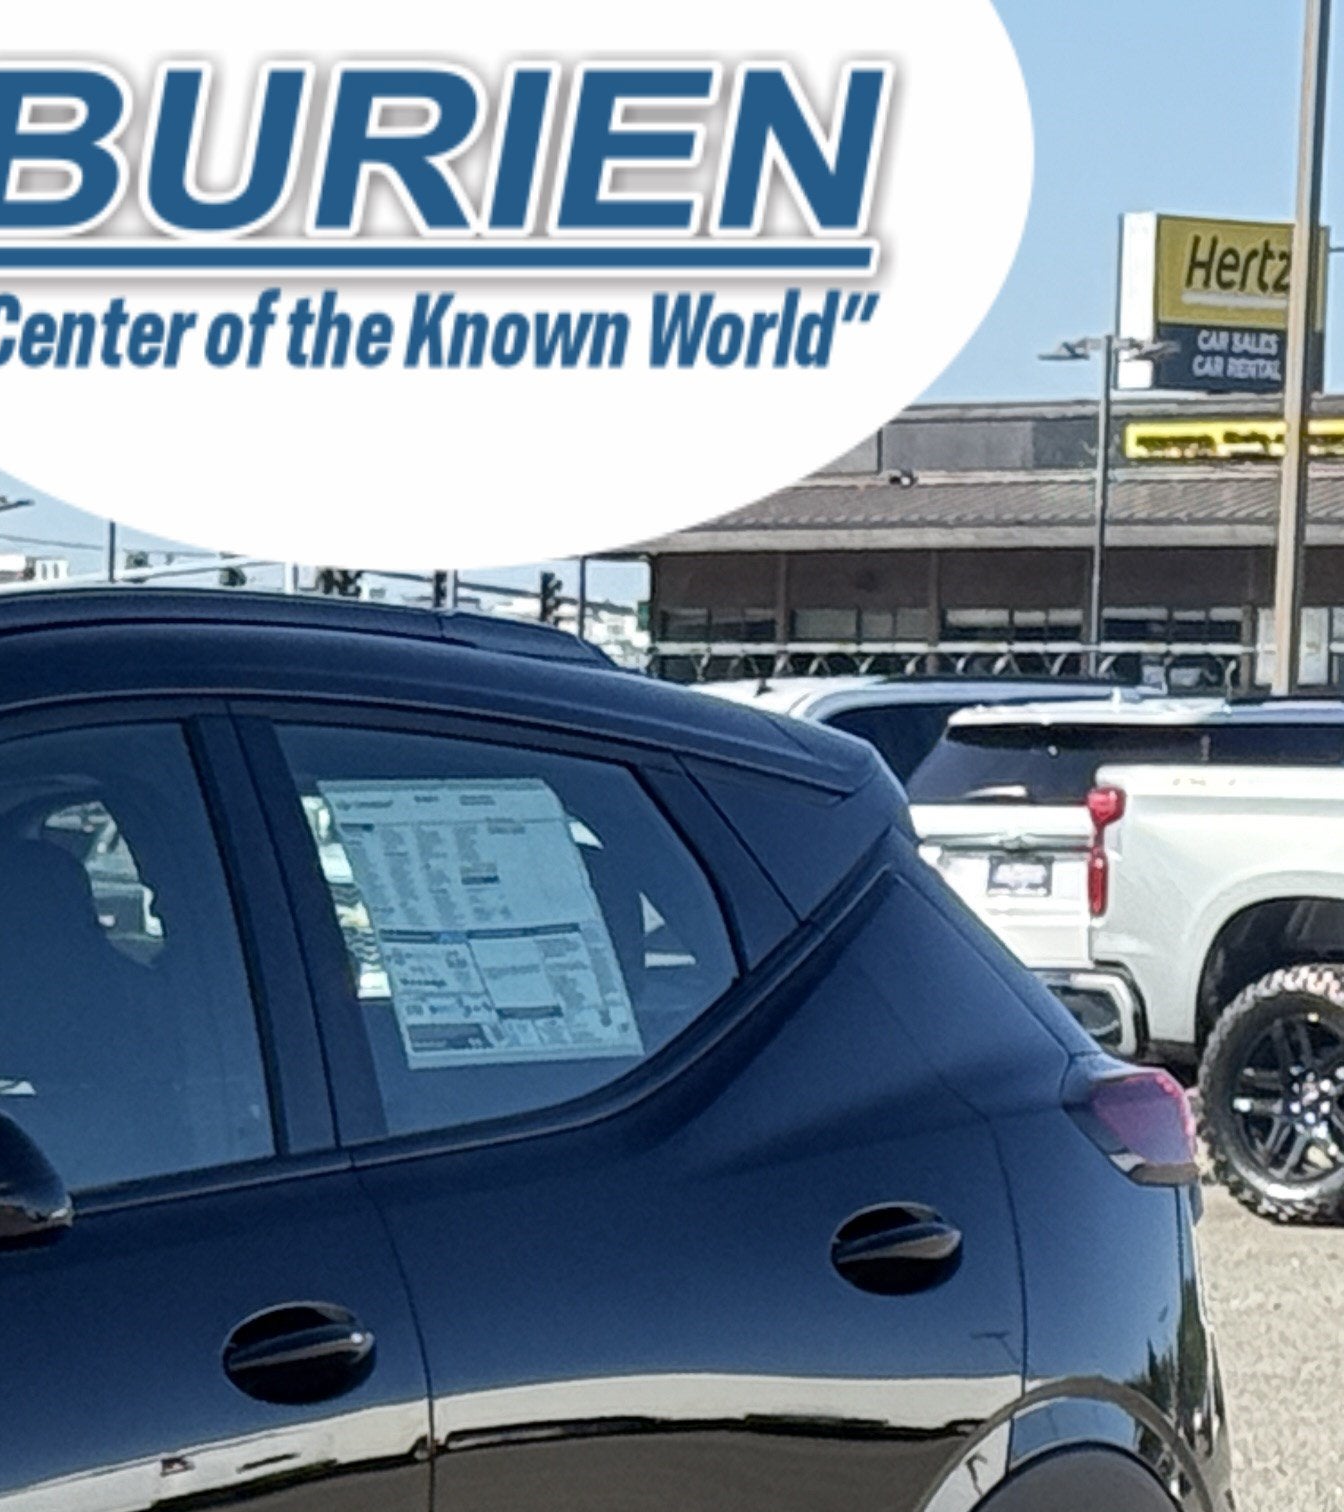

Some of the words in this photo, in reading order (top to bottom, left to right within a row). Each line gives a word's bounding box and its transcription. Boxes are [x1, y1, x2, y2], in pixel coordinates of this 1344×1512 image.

[1185, 234, 1291, 293] Hertz
[1197, 329, 1229, 352] CAR
[1232, 331, 1279, 356] SALES
[1192, 355, 1224, 377] CAR
[1226, 356, 1282, 381] RENTAL
